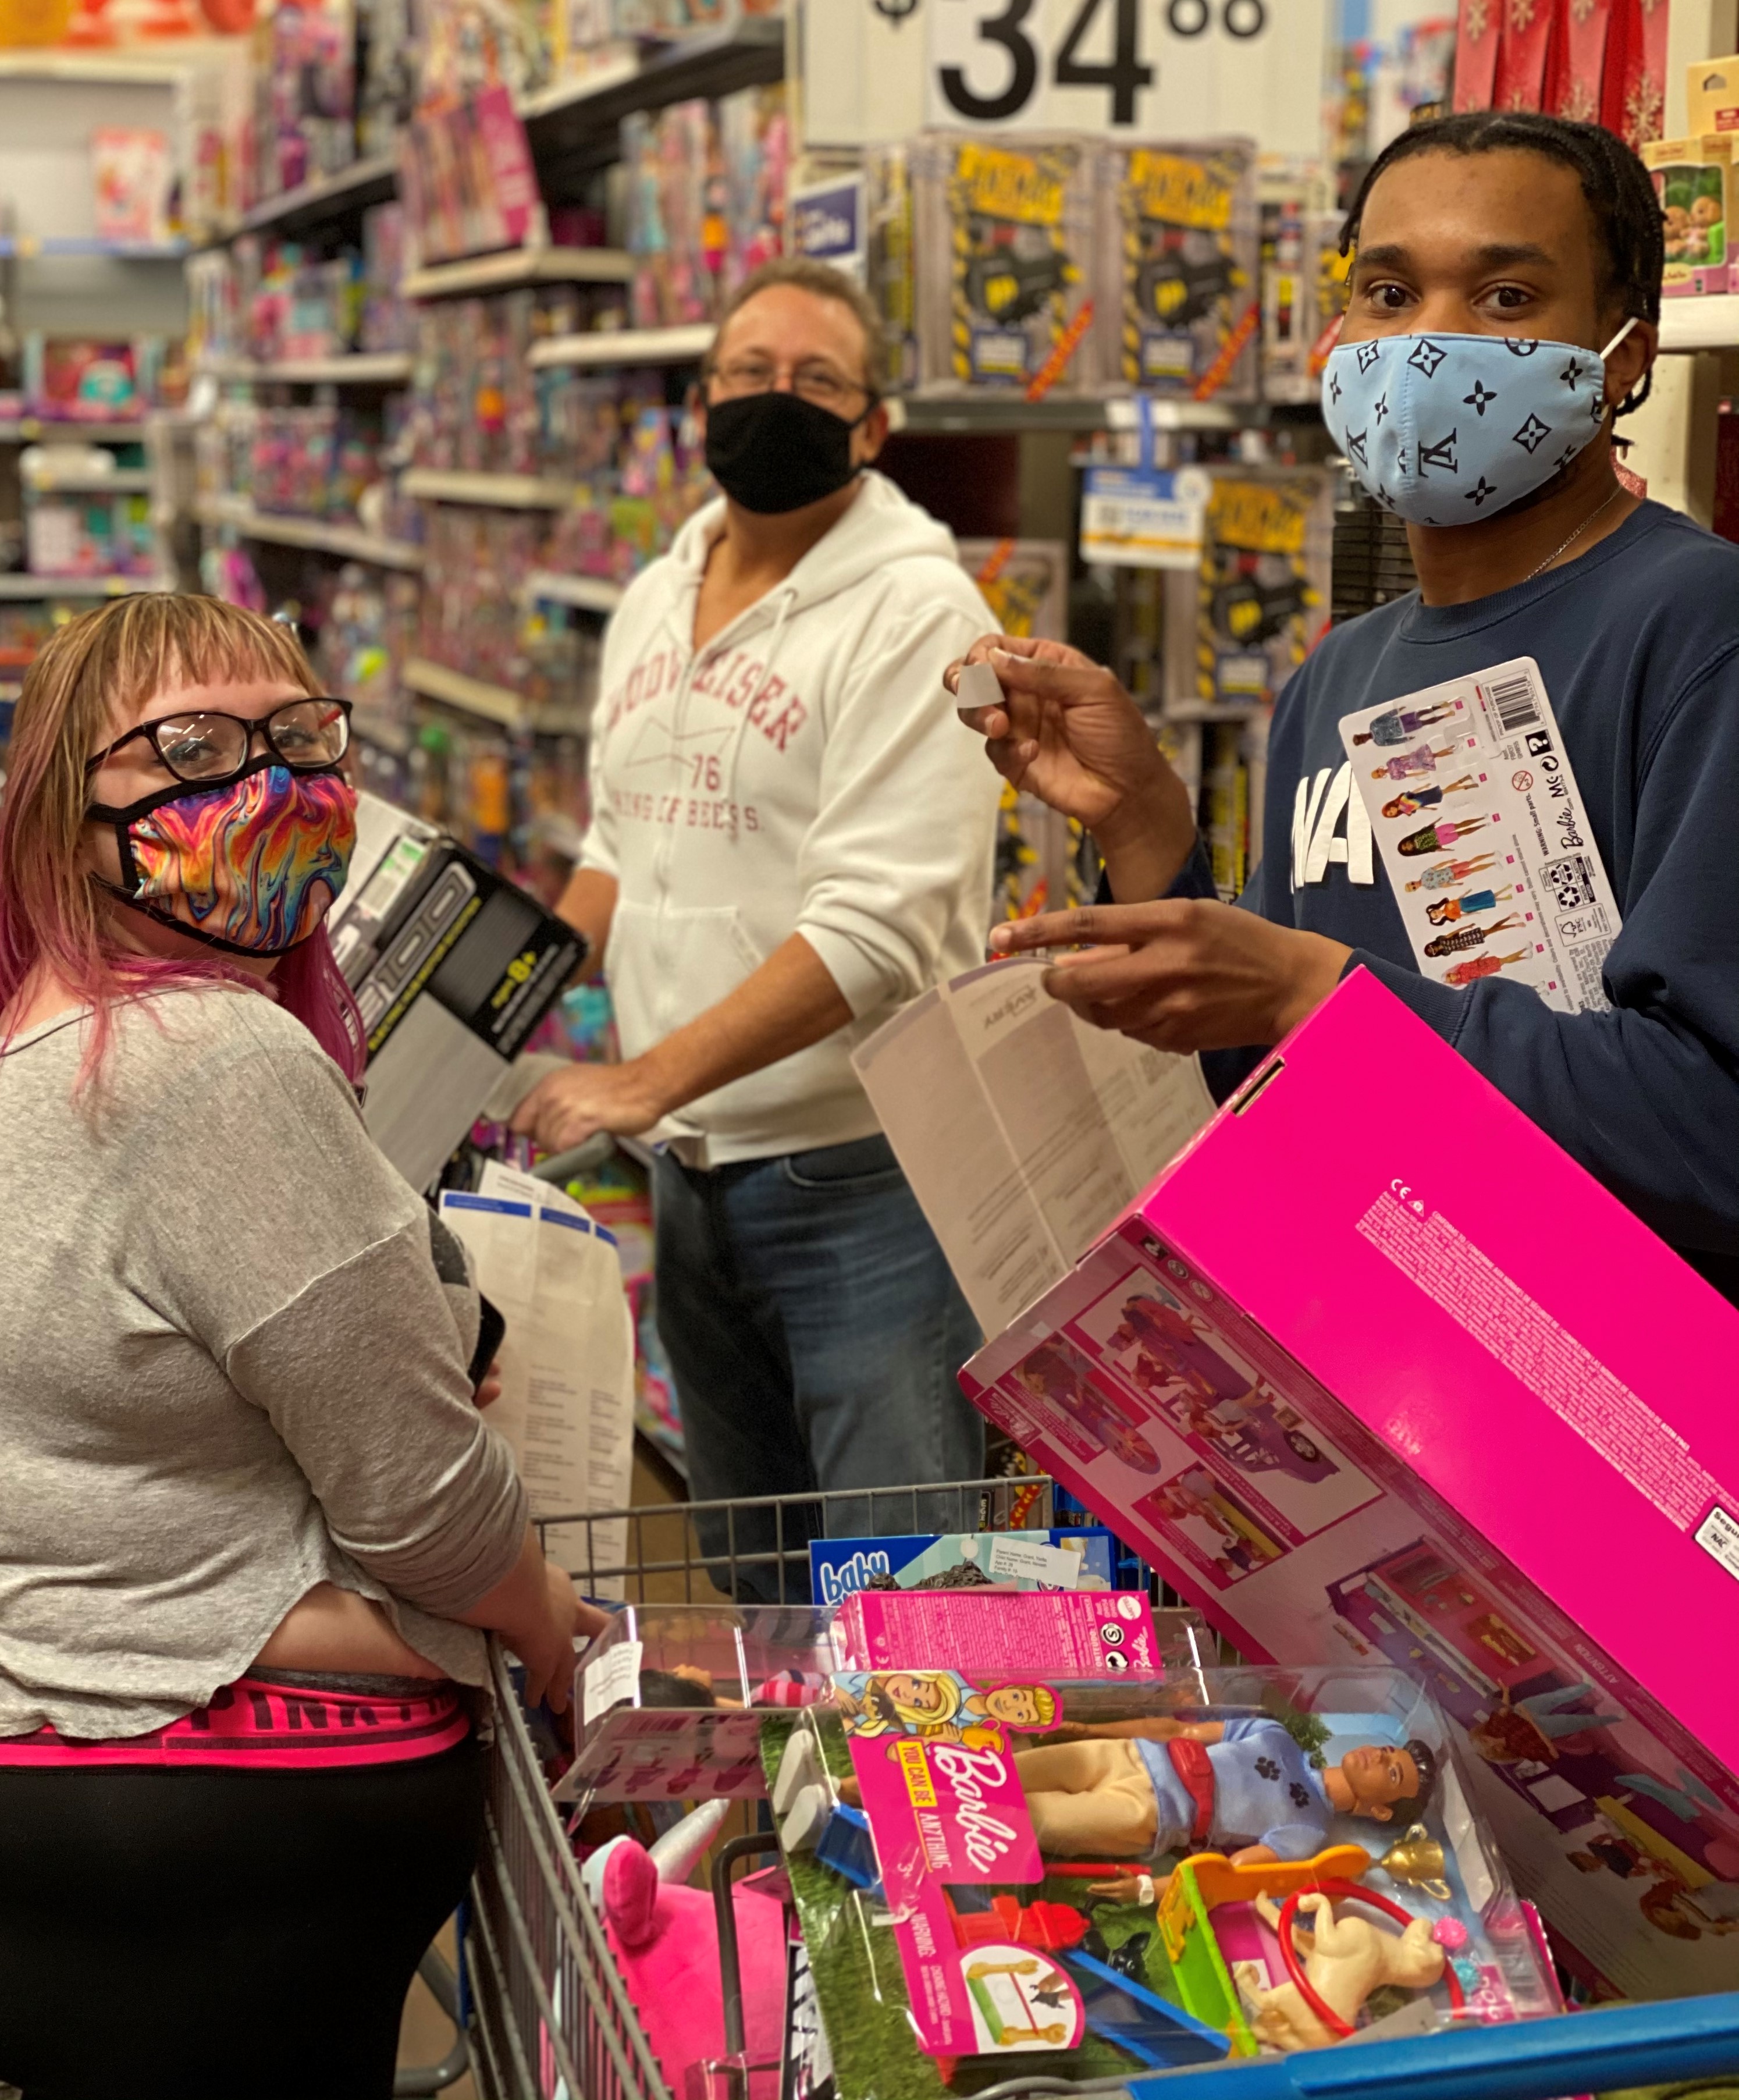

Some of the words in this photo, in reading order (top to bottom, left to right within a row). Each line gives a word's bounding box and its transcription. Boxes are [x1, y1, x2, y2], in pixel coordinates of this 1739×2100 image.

[691, 754, 721, 791] 76
[1524, 793, 1535, 811] parts.
[1530, 810, 1540, 827] Small
[1551, 806, 1584, 851] Barbie
[1535, 826, 1549, 855] WARNING:
[1571, 859, 1581, 879] PLASTIC
[1580, 884, 1588, 900] PAPER
[1574, 918, 1583, 933] FSC
[902, 1744, 922, 1767] YOU
[908, 1764, 927, 1789] CAN
[913, 1786, 931, 1805] BE
[930, 1743, 1016, 1874] Barbie
[919, 1808, 951, 1871] ANYTHING
